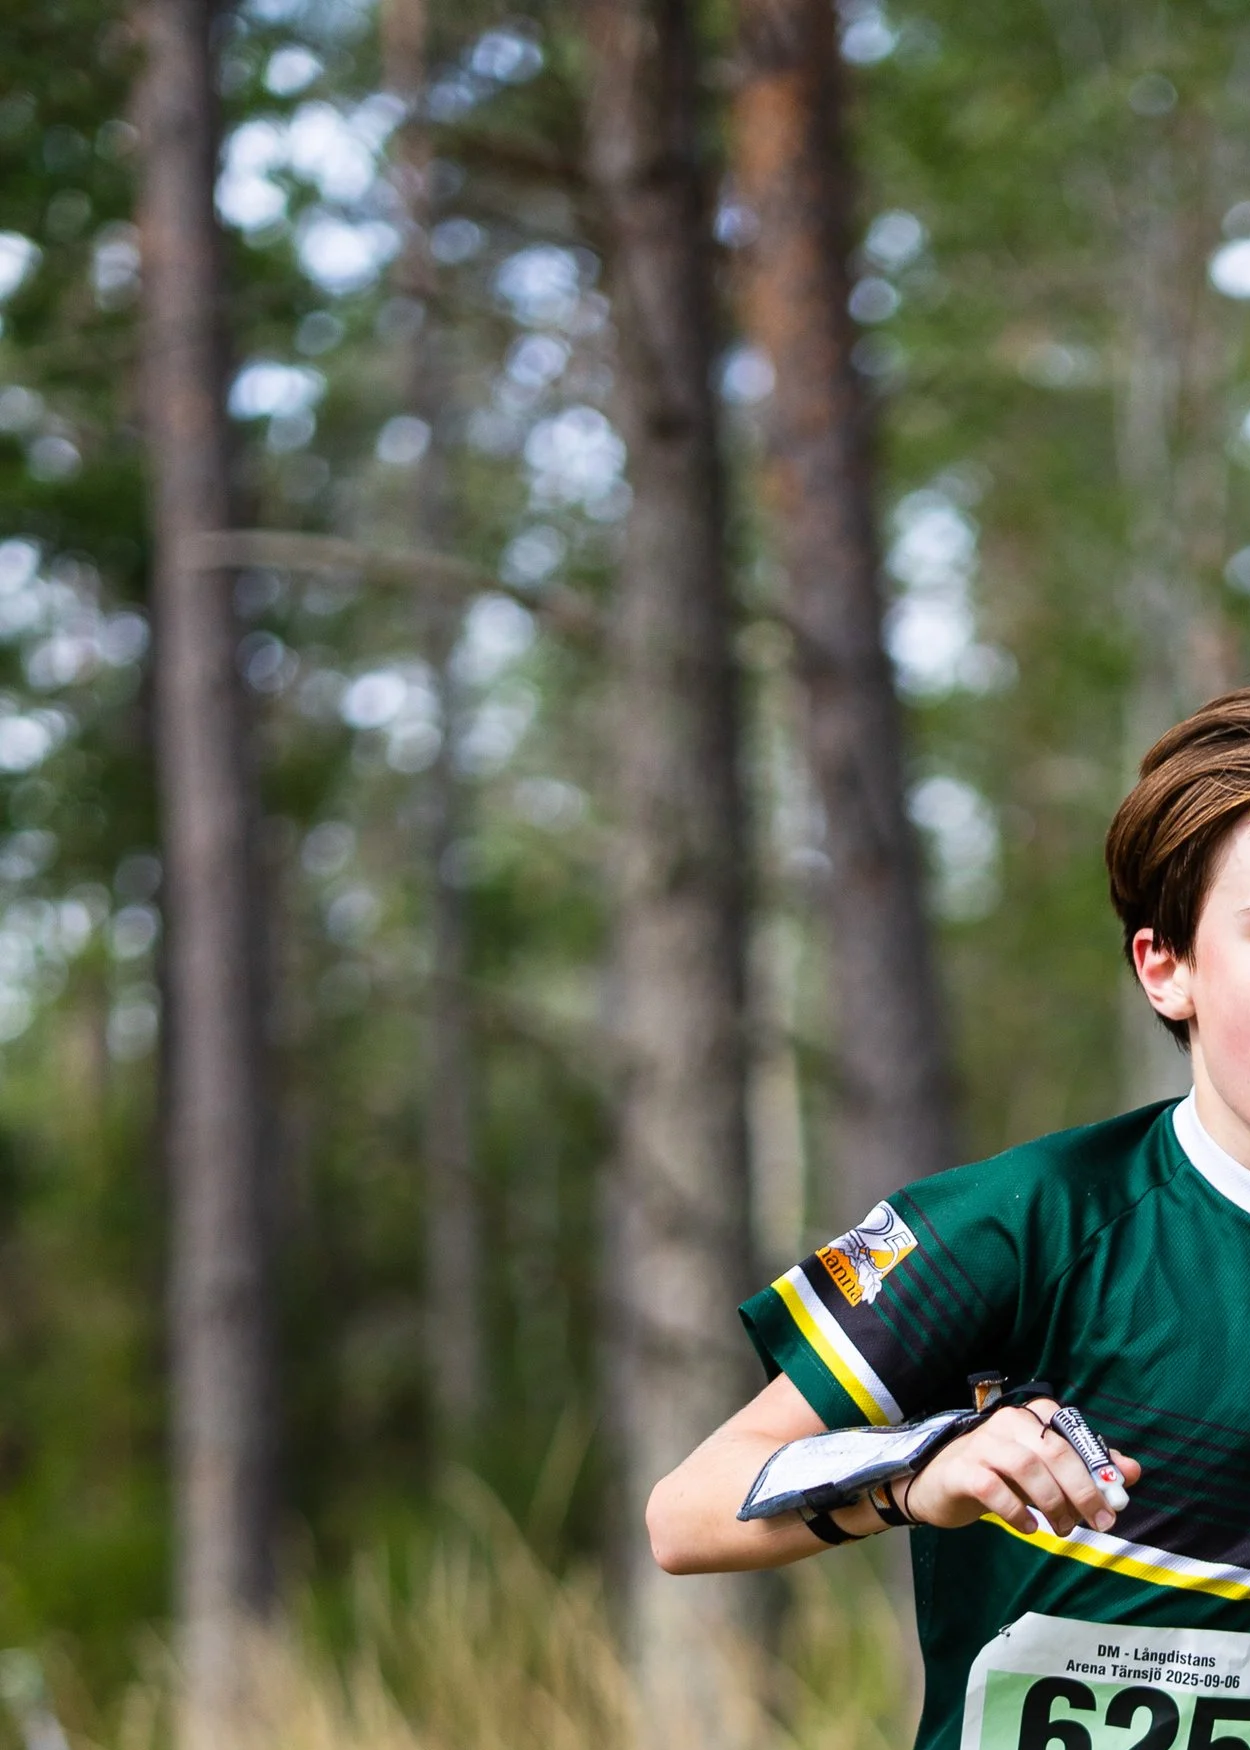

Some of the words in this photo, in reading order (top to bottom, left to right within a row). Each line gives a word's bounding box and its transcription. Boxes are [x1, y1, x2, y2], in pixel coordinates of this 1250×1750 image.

[1097, 1644, 1120, 1659] DM
[1133, 1647, 1216, 1668] Långdistans
[1066, 1659, 1106, 1675] Arena
[1111, 1664, 1162, 1682] Tärnsjö
[1166, 1669, 1241, 1689] 2025-09-06
